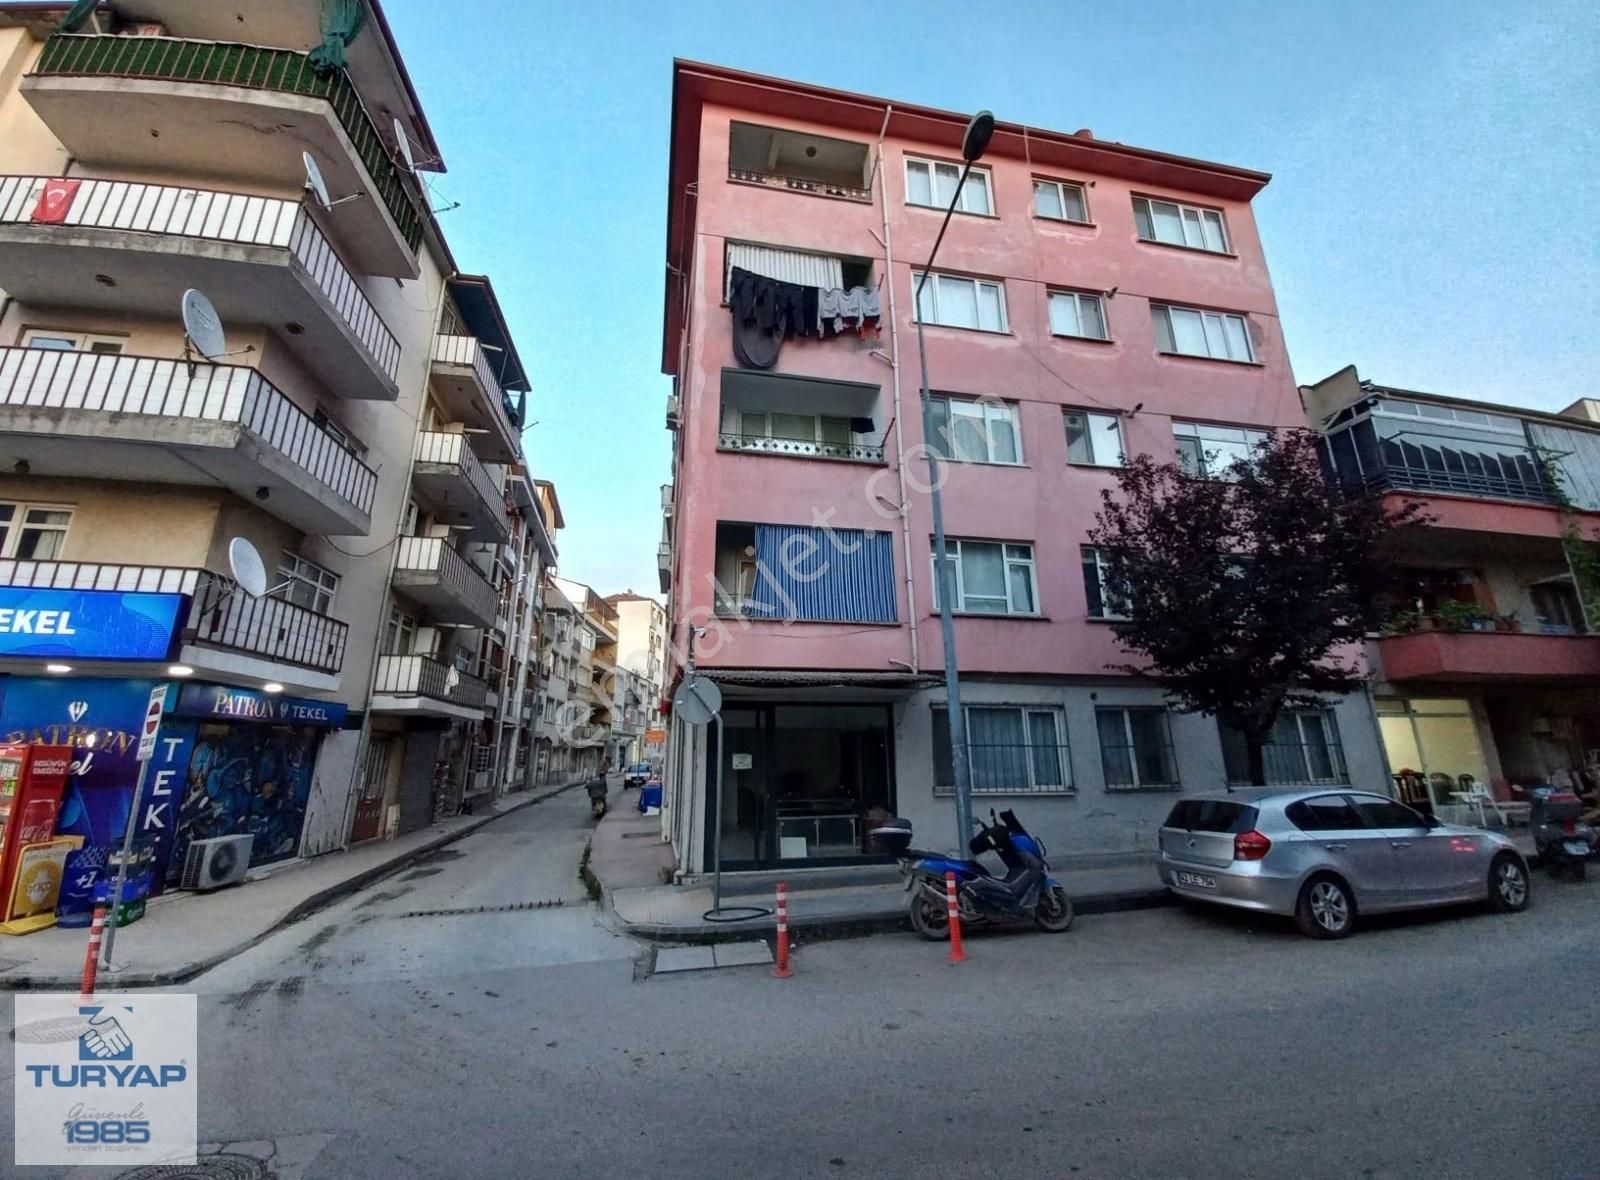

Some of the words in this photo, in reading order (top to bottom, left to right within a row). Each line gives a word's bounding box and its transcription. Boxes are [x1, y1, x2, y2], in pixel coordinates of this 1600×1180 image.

[0, 608, 76, 635] EKEL
[212, 691, 275, 719] PATRON
[291, 705, 328, 721] TEKEL
